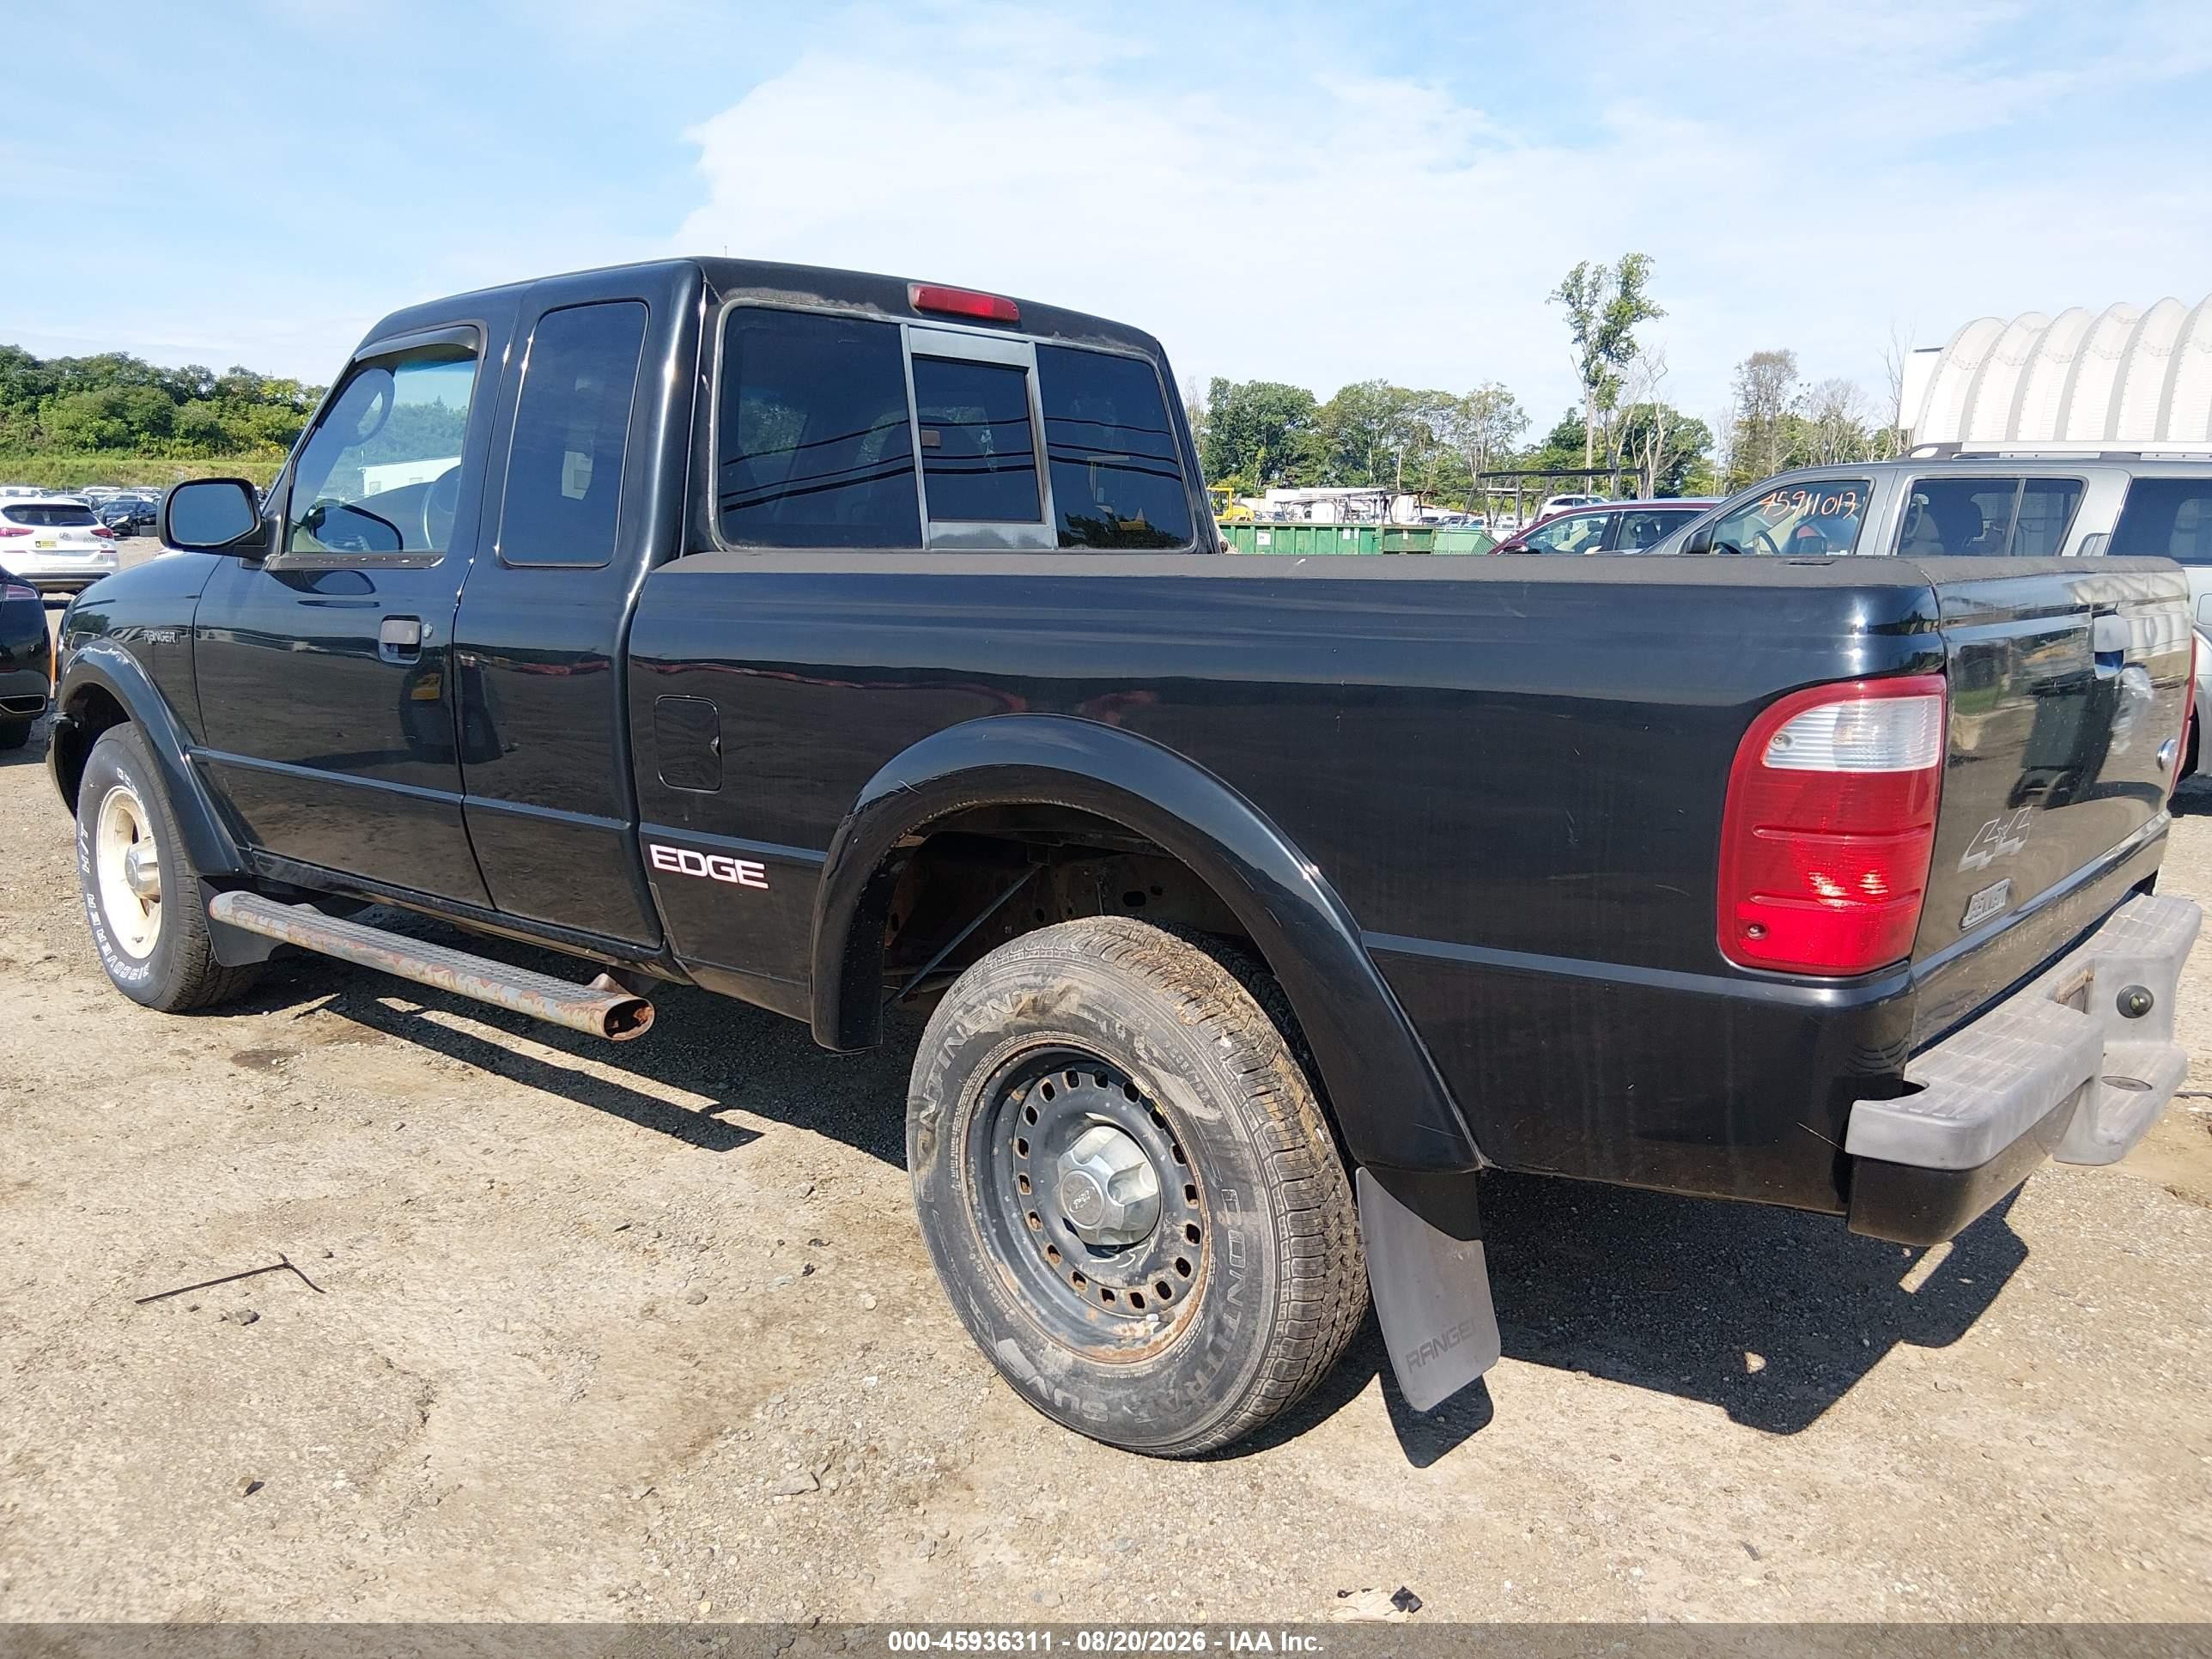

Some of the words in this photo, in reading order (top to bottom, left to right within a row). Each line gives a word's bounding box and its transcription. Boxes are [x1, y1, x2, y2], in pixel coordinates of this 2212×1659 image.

[81, 822, 91, 874] H/T
[649, 843, 769, 890] EDGE
[87, 893, 150, 980] DISCOVERER
